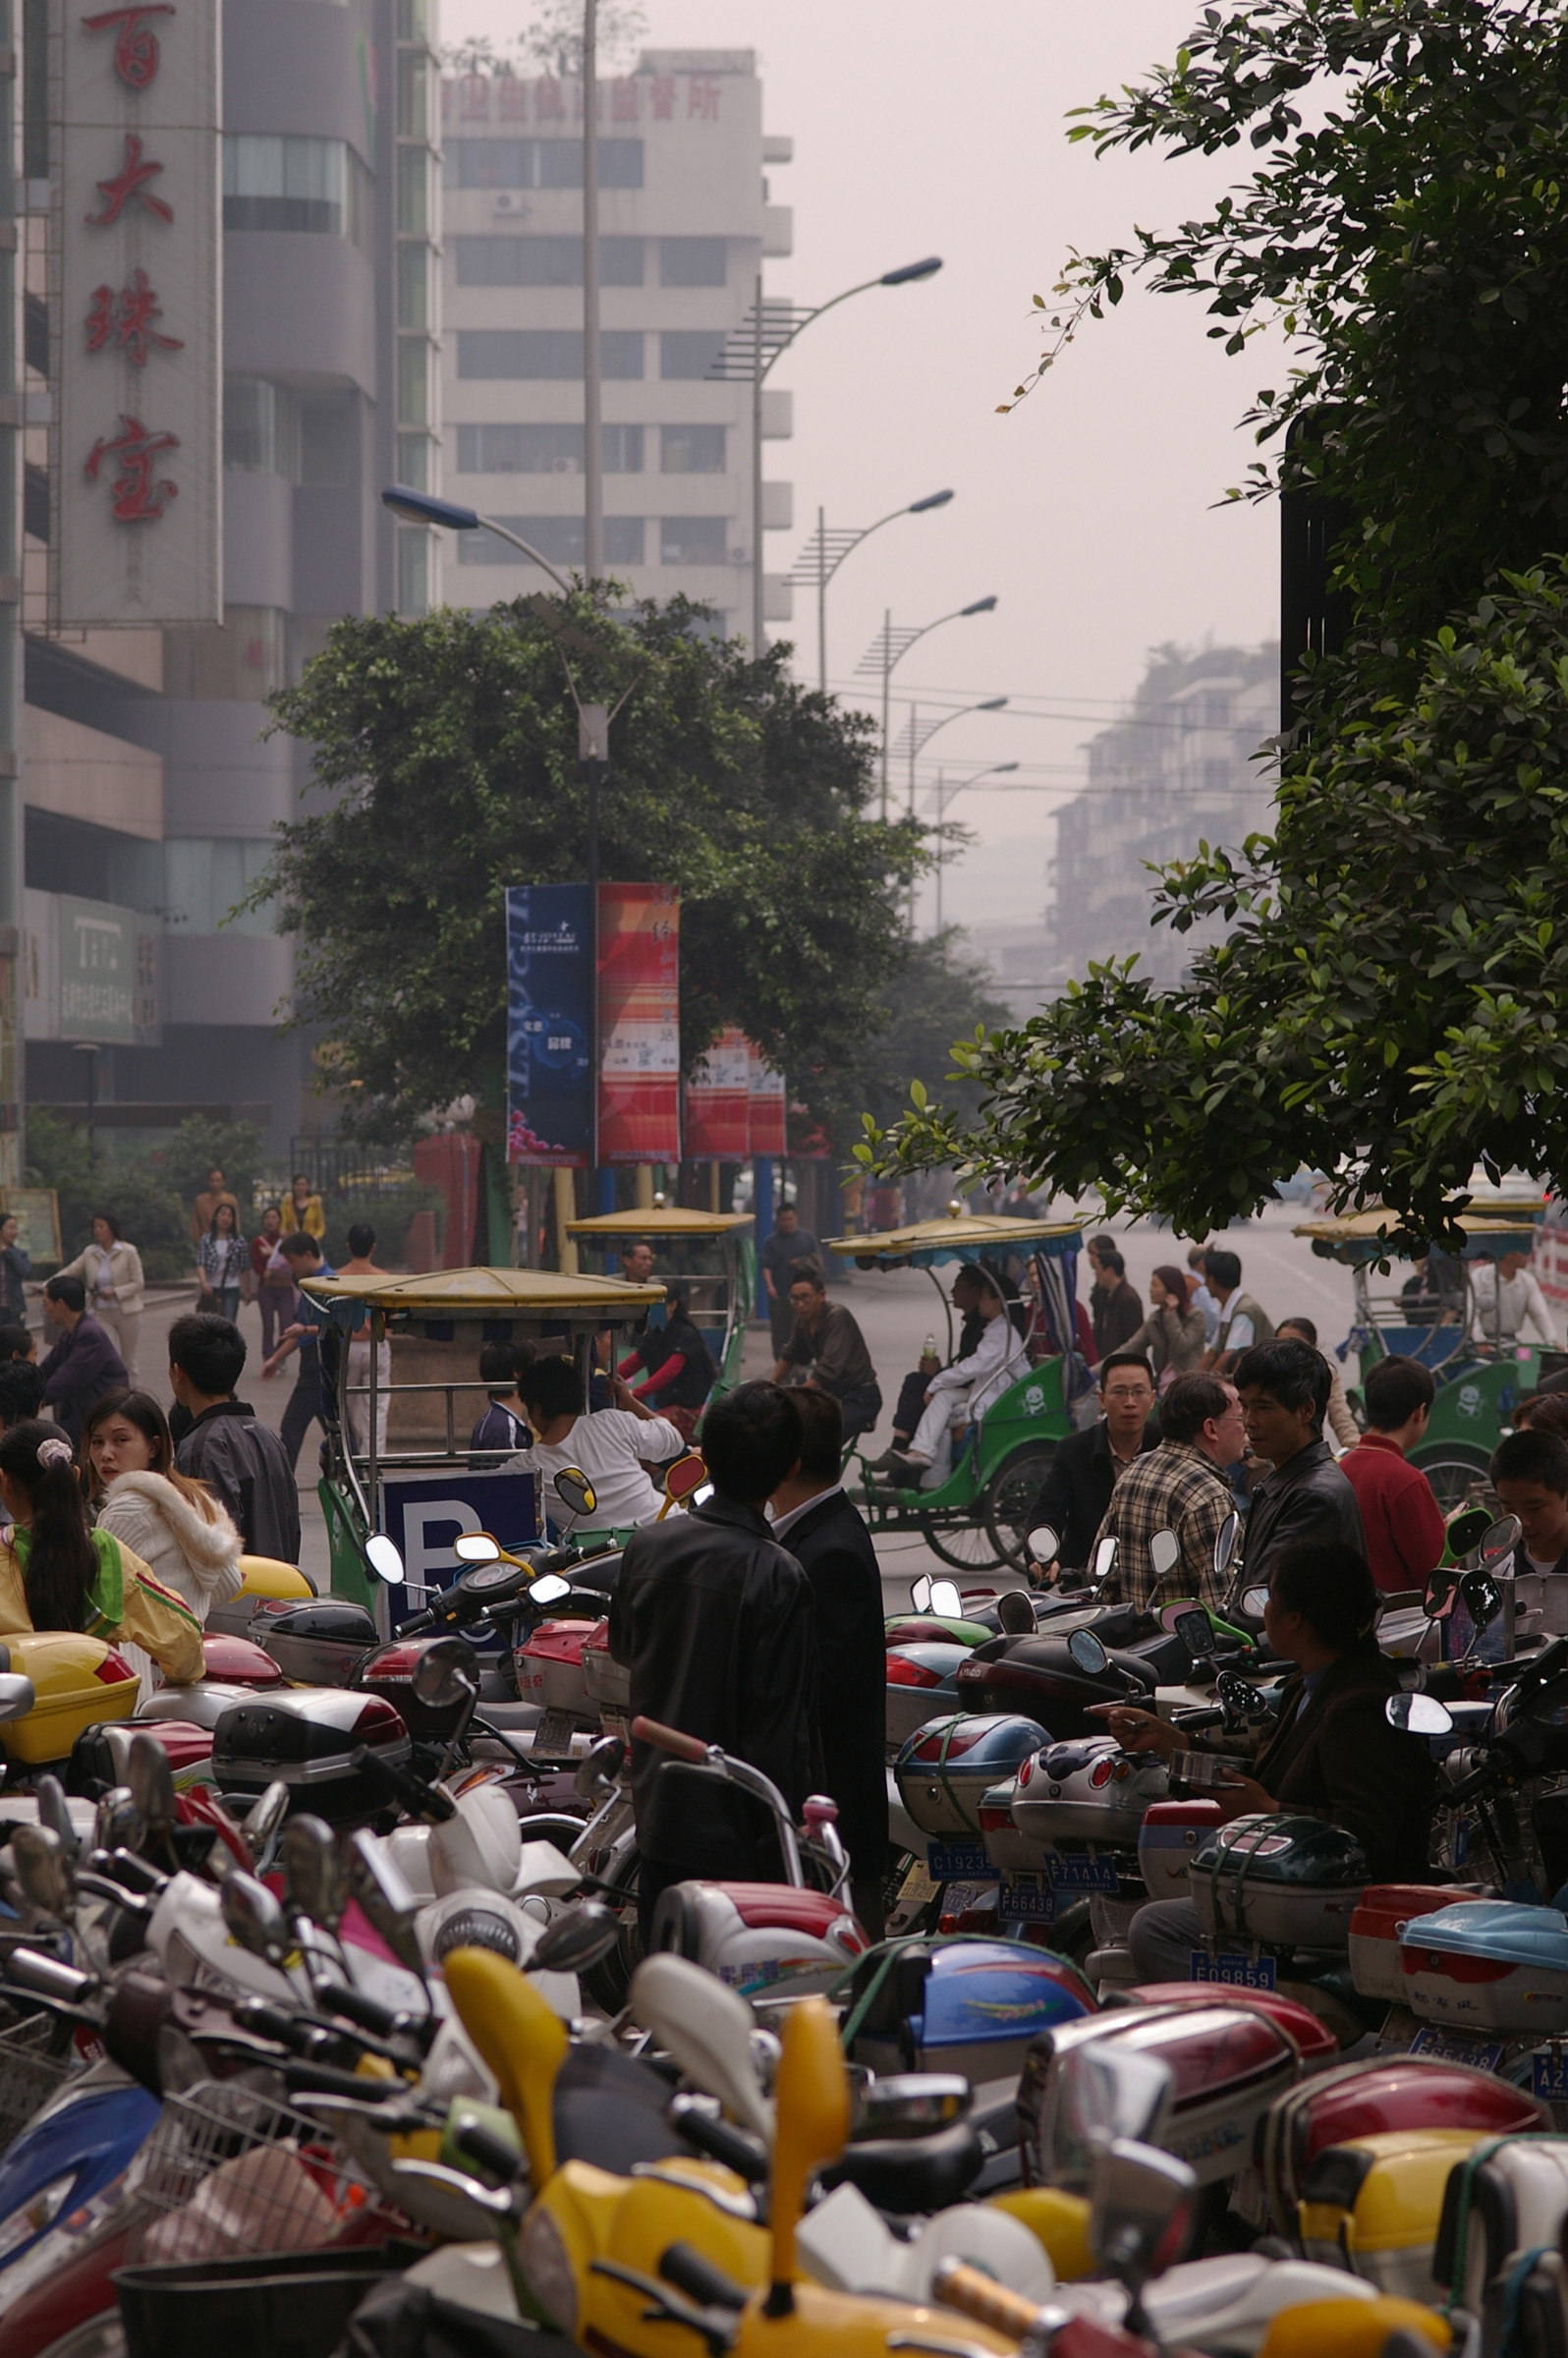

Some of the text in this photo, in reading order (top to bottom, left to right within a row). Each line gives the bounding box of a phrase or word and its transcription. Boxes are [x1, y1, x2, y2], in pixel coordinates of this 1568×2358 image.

[81, 3, 185, 522] 百大珠宝
[402, 1499, 483, 1610] P
[1002, 1894, 1053, 1912] F66438
[1050, 1865, 1111, 1881] F71414
